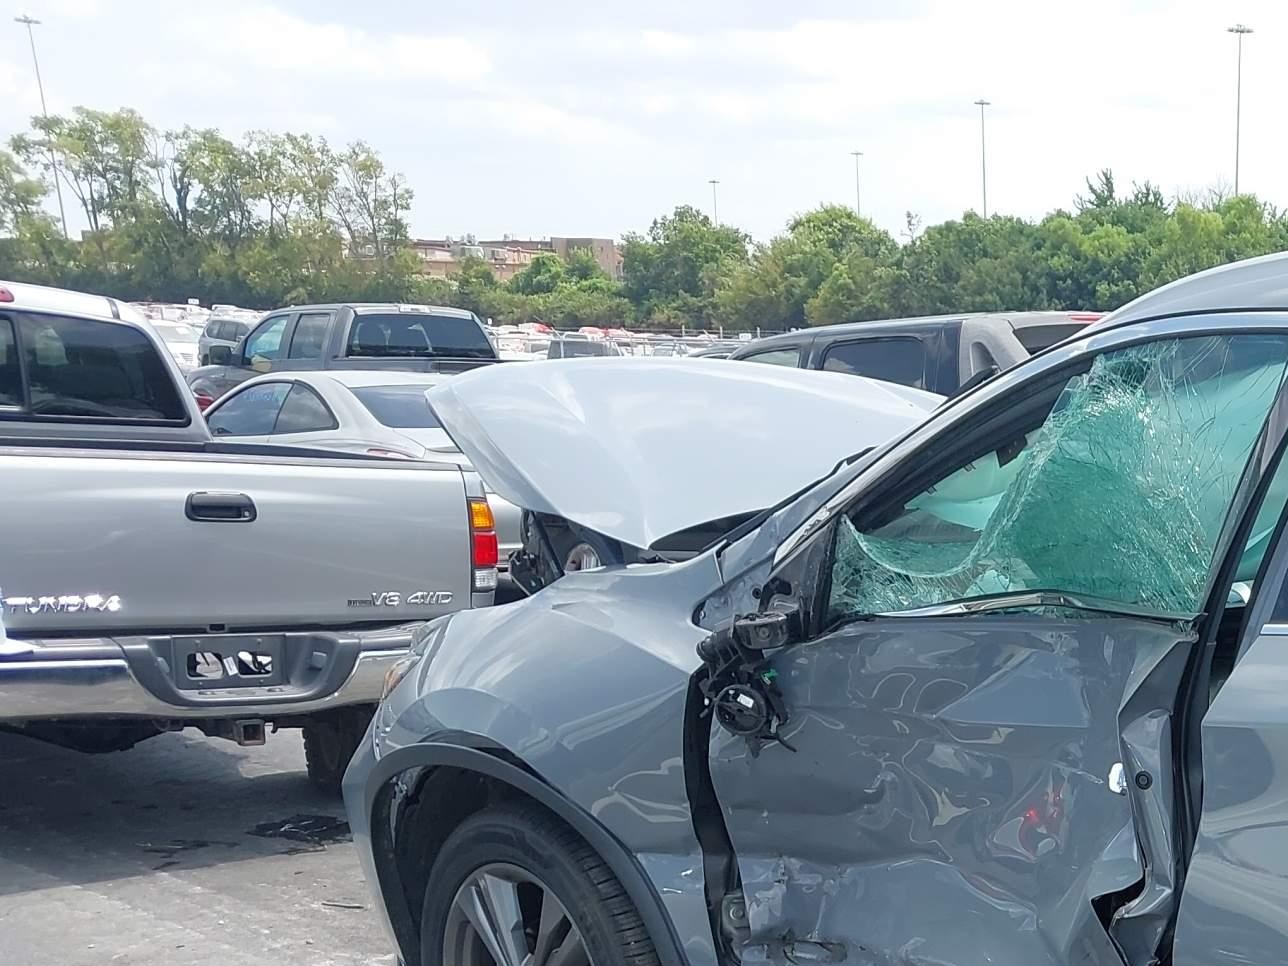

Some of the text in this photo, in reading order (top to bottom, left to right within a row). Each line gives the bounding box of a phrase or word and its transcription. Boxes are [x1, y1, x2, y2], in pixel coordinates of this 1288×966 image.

[4, 594, 121, 613] TUNDRA
[371, 591, 401, 608] V8
[407, 591, 454, 606] 4WD
